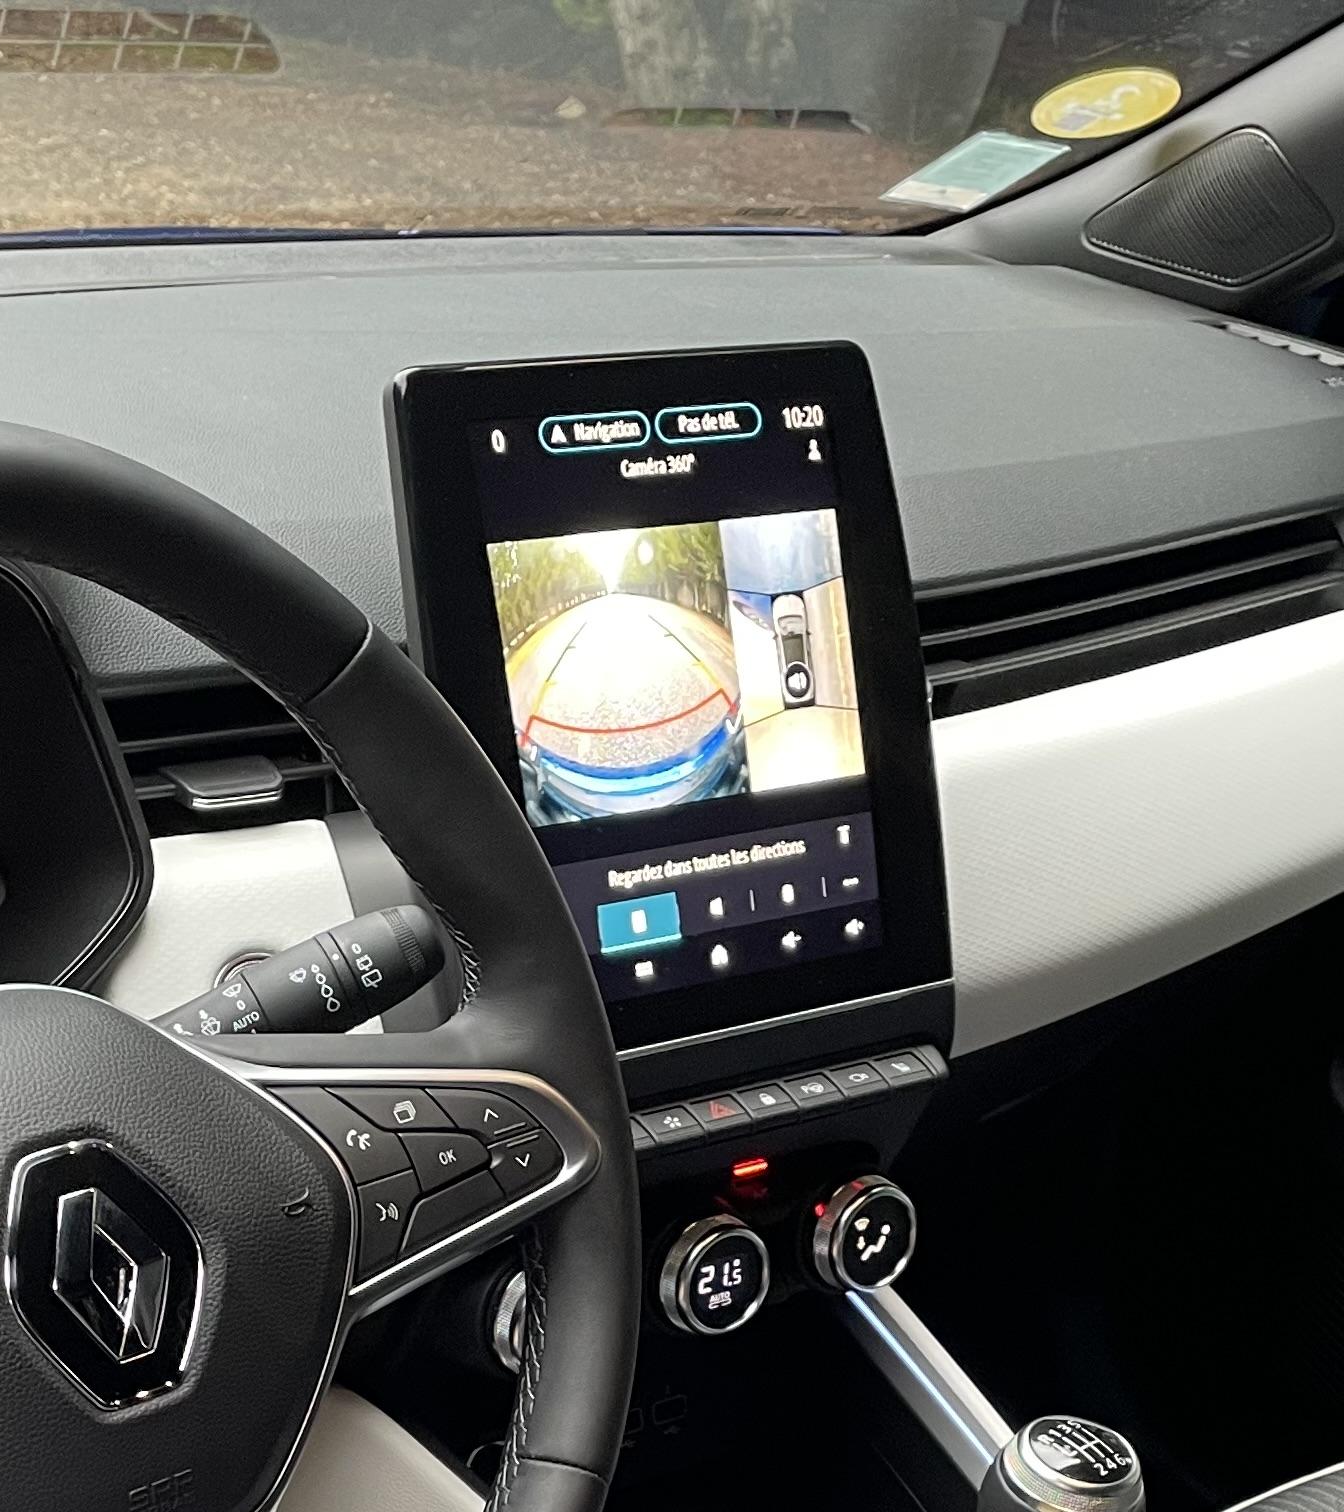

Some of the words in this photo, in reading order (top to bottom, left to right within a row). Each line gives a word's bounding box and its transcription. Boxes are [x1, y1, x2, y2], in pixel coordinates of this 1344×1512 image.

[677, 414, 701, 433] Pas
[701, 412, 718, 431] de
[782, 404, 824, 429] 10:20
[572, 419, 642, 443] Navigation
[620, 456, 666, 479] Caméra
[608, 862, 663, 889] Regardez
[663, 859, 693, 879] dans
[692, 852, 731, 874] toutes
[730, 848, 750, 867] les
[749, 839, 806, 863] directions
[232, 1011, 260, 1032] AUTO
[438, 1149, 457, 1166] OK
[709, 1291, 731, 1304] AUTO
[1093, 1463, 1109, 1476] 2
[1105, 1457, 1118, 1469] 4
